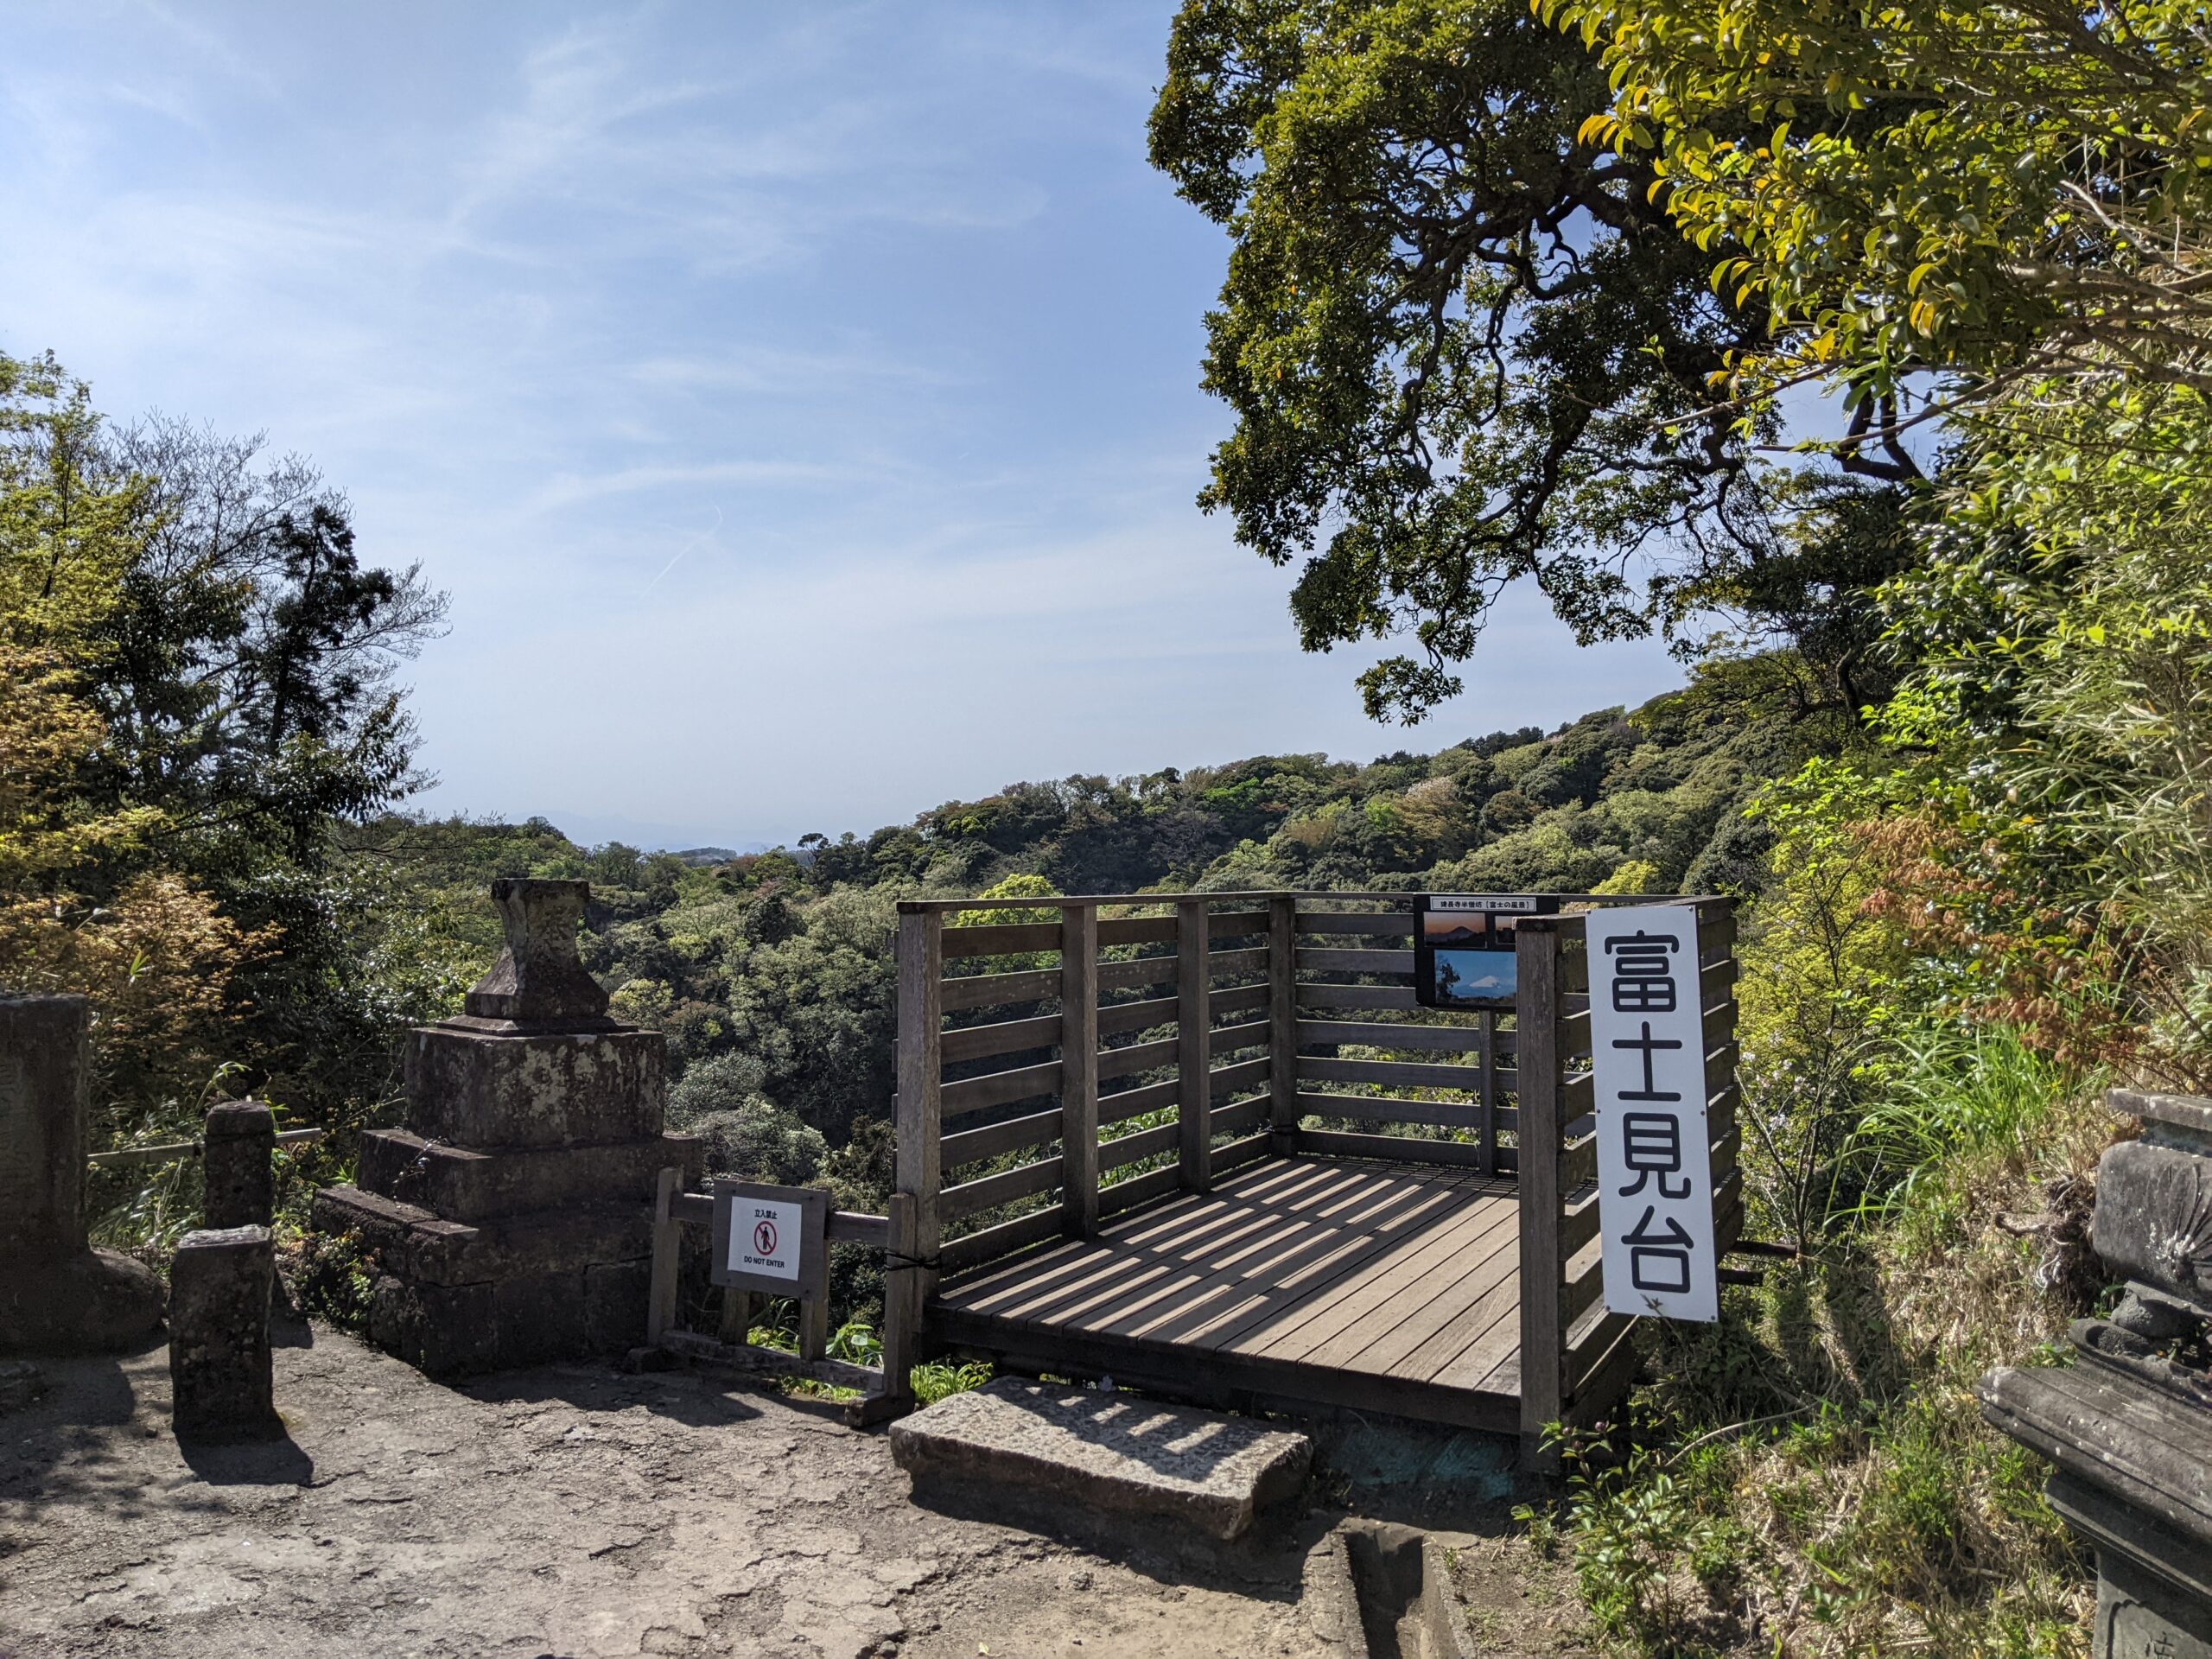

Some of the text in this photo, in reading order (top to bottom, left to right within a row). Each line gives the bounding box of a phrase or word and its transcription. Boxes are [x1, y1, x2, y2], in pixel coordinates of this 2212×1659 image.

[1605, 929, 1694, 1294] 富士見台
[754, 1209, 778, 1219] 立入禁止
[766, 1259, 785, 1268] ENTER
